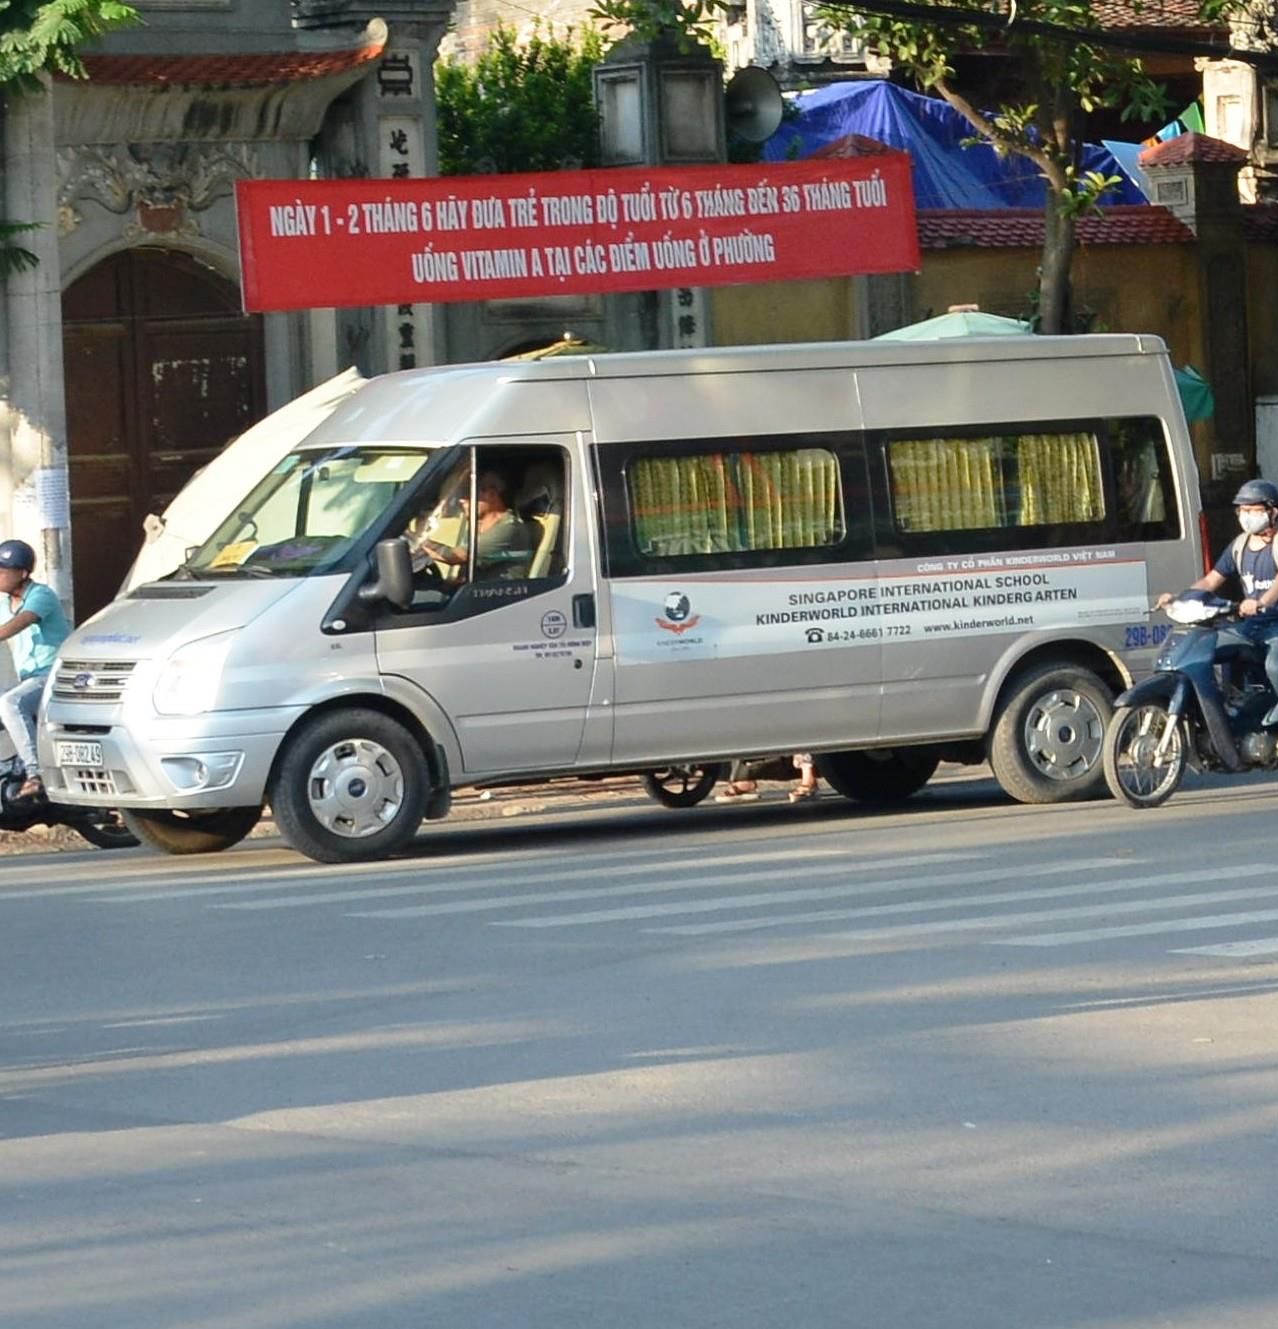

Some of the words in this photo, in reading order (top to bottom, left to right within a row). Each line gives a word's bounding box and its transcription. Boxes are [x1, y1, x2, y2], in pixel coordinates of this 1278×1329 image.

[270, 199, 316, 236] NGÀY
[321, 205, 331, 235] 1
[348, 203, 359, 234] 2
[362, 196, 418, 233] THÁNG
[421, 203, 432, 231] 6
[436, 195, 468, 230] HÃY
[471, 196, 506, 229] ĐƯA
[507, 187, 538, 227] TRẺ
[541, 194, 592, 226] TRONG
[596, 188, 617, 229] ĐỘ
[621, 181, 656, 221] TUỔI
[659, 185, 680, 220] TỪ
[682, 191, 692, 218] 6
[695, 183, 745, 217] THÁNG
[747, 177, 779, 215] ĐẾN
[782, 184, 800, 213] 36
[803, 177, 851, 211] THÁNG
[853, 168, 887, 207] TUỔI
[411, 241, 459, 283] UỐNG
[460, 247, 527, 280] VITAMIN
[530, 247, 544, 277] A
[545, 246, 571, 282] TẠI
[573, 238, 607, 274] CÁC
[609, 230, 651, 272] ĐIỂM
[653, 230, 697, 269] UỐNG
[699, 228, 709, 266] Ở
[713, 228, 776, 265] PHƯỜNG
[917, 561, 943, 573] CÔNG
[947, 562, 959, 571] TY
[1005, 553, 1070, 566] KINDERWORLD
[1096, 550, 1116, 560] NAM
[788, 589, 877, 606] SINGAPORE
[880, 578, 991, 598] INTERNATIONAL
[995, 573, 1050, 588] SCHOOL
[756, 603, 857, 626] KINDERWORLD
[860, 596, 968, 617] INTERNATIONAL
[887, 624, 911, 637] 7722
[924, 614, 1034, 634] www.kinderworld.net
[1125, 624, 1173, 648] 29B-08
